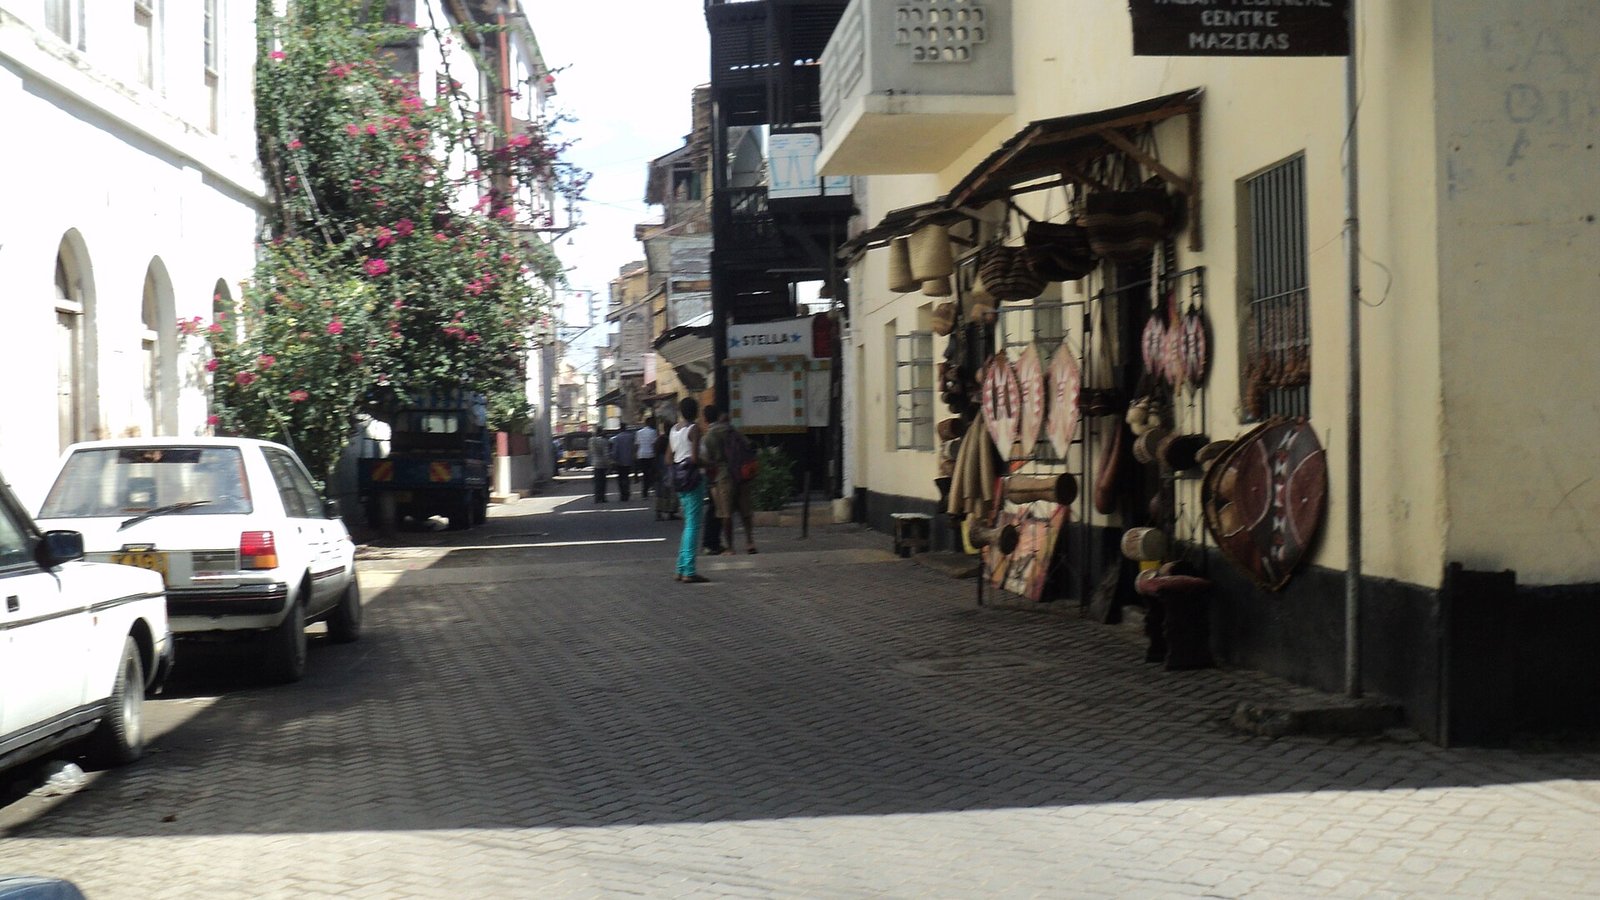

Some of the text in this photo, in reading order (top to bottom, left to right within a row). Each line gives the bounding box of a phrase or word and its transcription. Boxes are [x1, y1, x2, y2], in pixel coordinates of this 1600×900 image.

[1200, 10, 1279, 27] CENTRE
[1188, 32, 1290, 50] MAZERAS
[742, 333, 789, 346] STELLA
